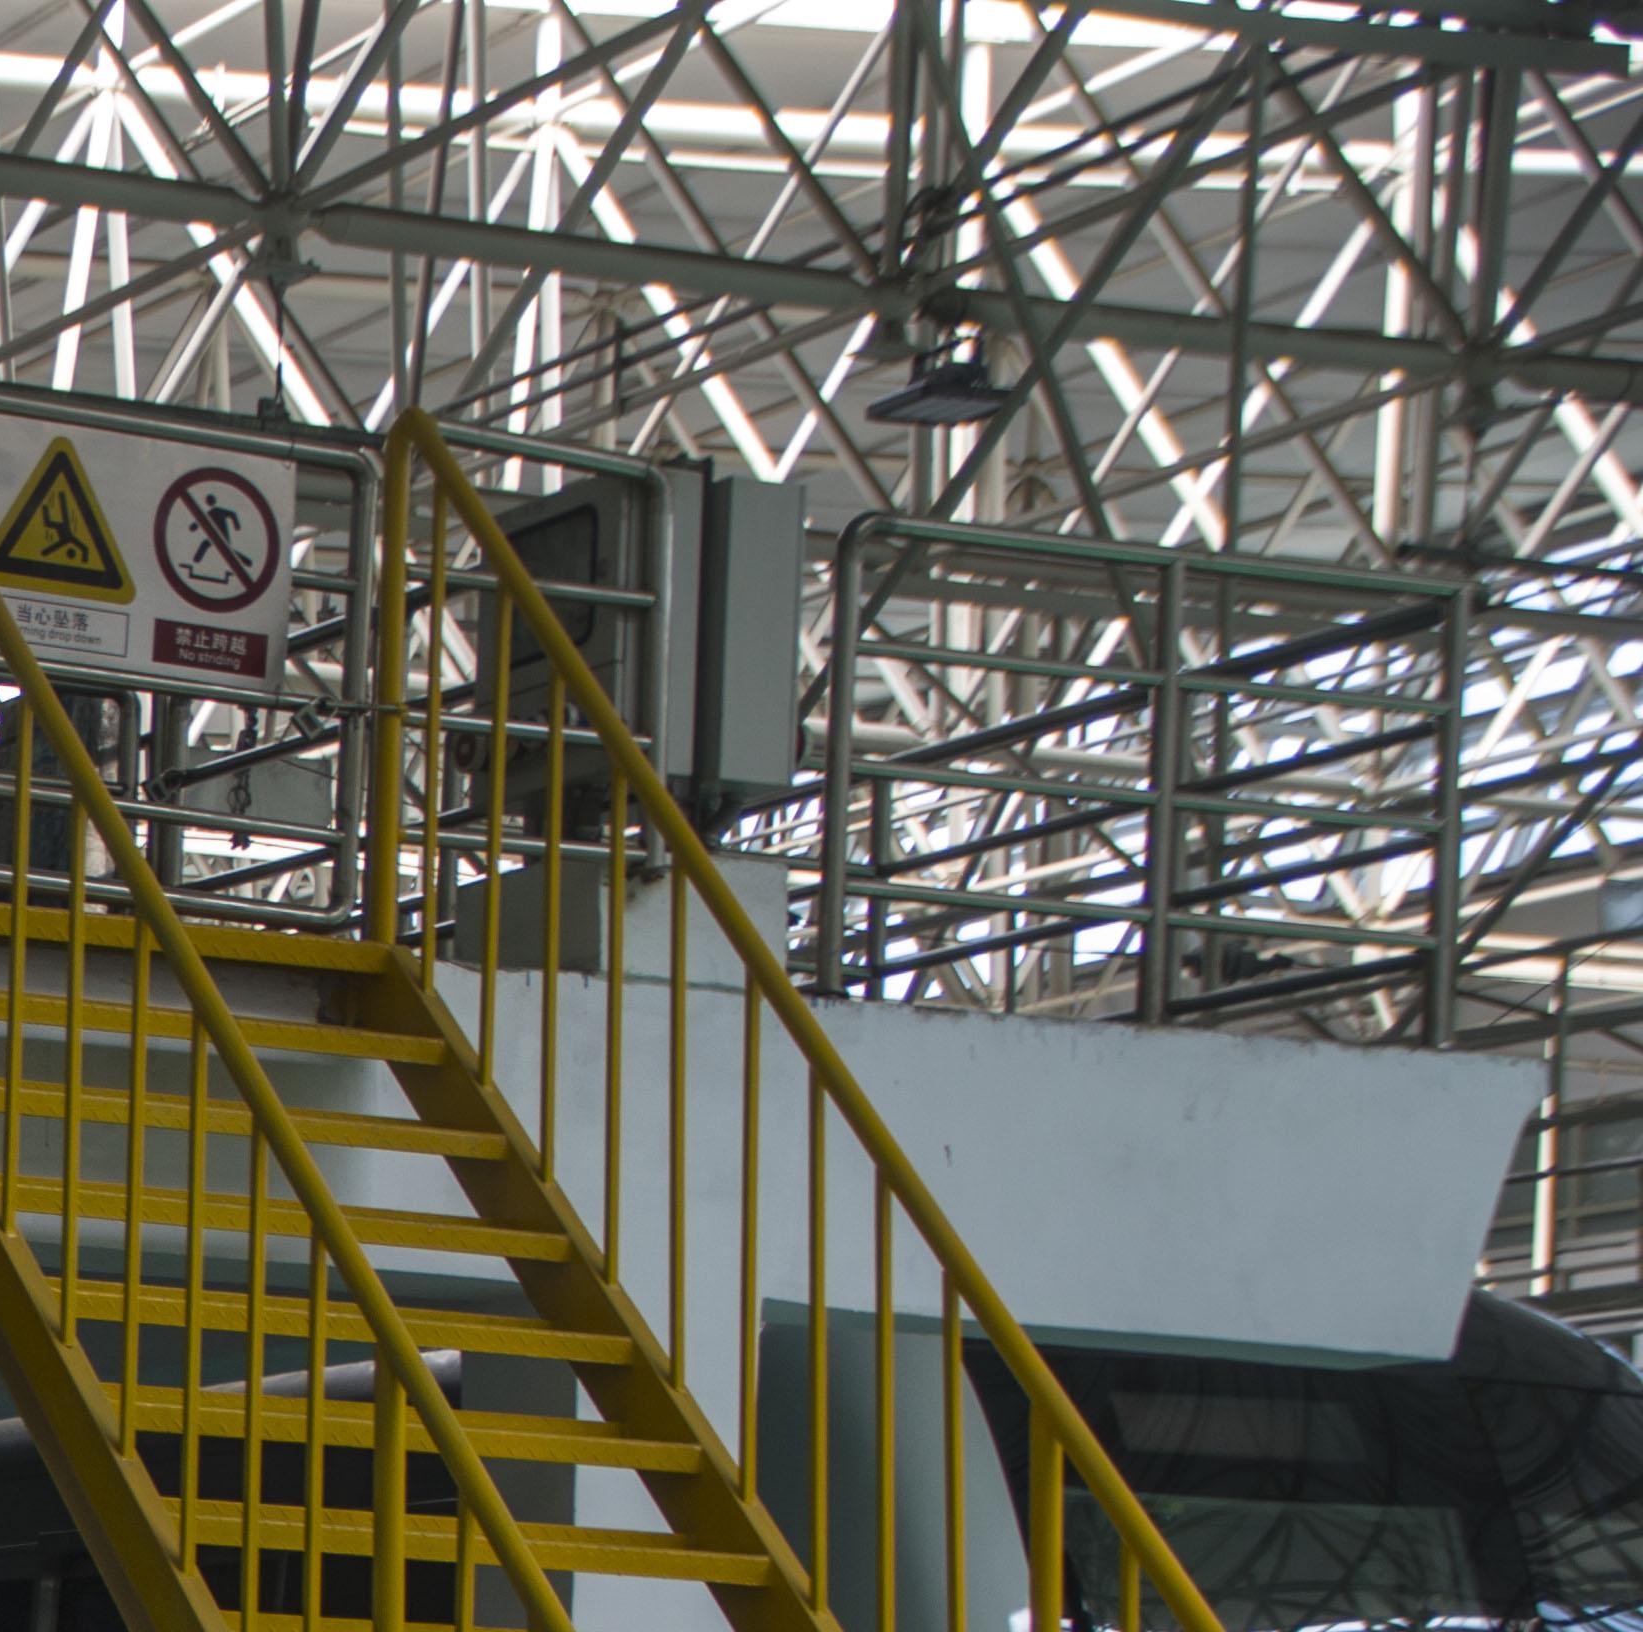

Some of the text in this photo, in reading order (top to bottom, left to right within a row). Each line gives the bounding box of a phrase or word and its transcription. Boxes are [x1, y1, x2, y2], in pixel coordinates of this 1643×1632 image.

[16, 602, 90, 633] 当心坠落
[48, 628, 72, 643] drop
[74, 632, 102, 645] down
[175, 626, 248, 656] 禁止跨越
[179, 647, 196, 662] No
